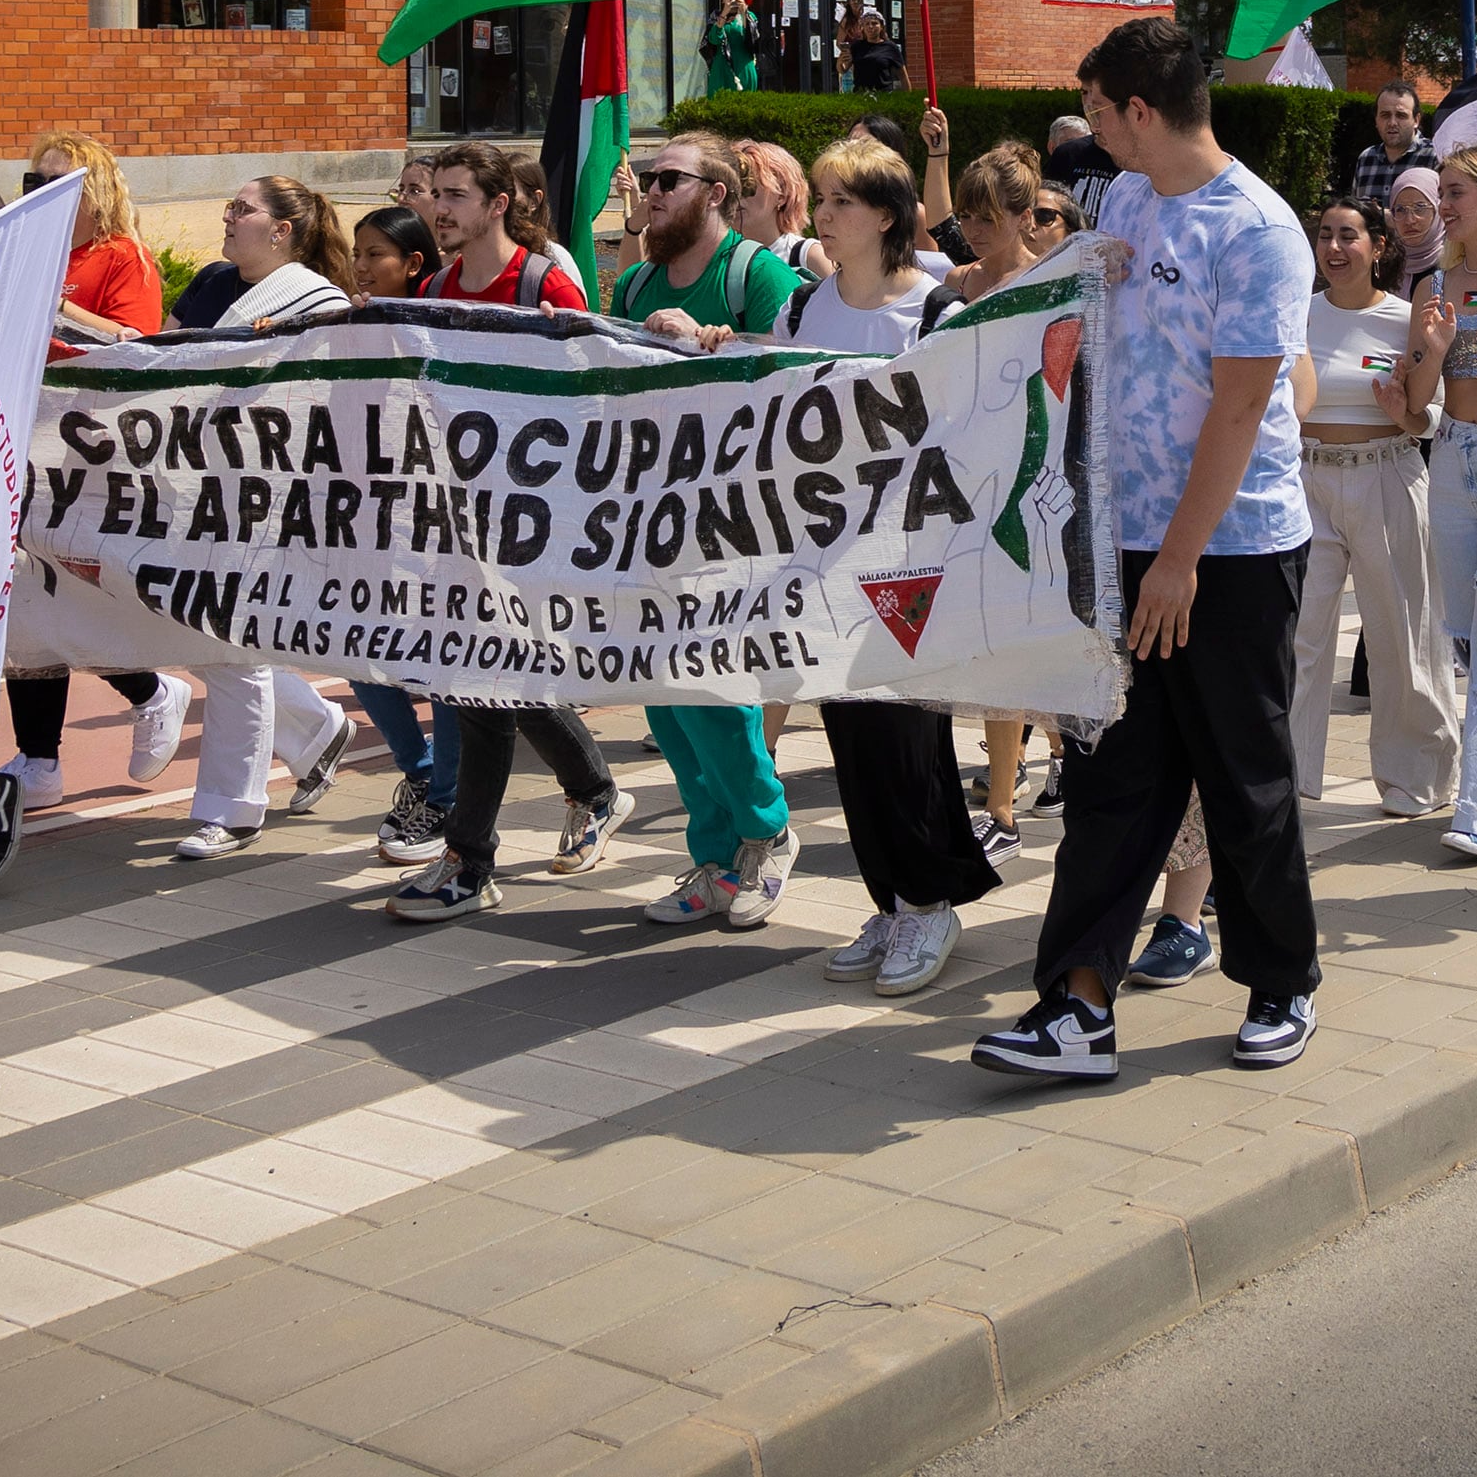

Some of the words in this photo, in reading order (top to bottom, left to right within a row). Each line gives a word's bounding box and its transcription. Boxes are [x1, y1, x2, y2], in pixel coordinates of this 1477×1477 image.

[59, 405, 343, 474] CONTRA
[365, 404, 435, 475] LA
[446, 361, 929, 493] OCUPACIÓN
[45, 467, 87, 529] Y
[98, 471, 168, 540] EL
[185, 475, 552, 567] APARTHEID
[571, 446, 976, 572] SIONISTA
[135, 563, 242, 643] FIN
[247, 571, 293, 607] AL
[318, 578, 530, 628] COMERCIO
[549, 593, 607, 633] DE
[639, 577, 804, 633] ARMAS
[903, 564, 945, 578] PALESTINA
[242, 615, 261, 650] A
[273, 616, 331, 657] LAS
[344, 624, 567, 677] RELACIONES
[575, 644, 656, 683] CON
[668, 630, 820, 680] ISRAEL
